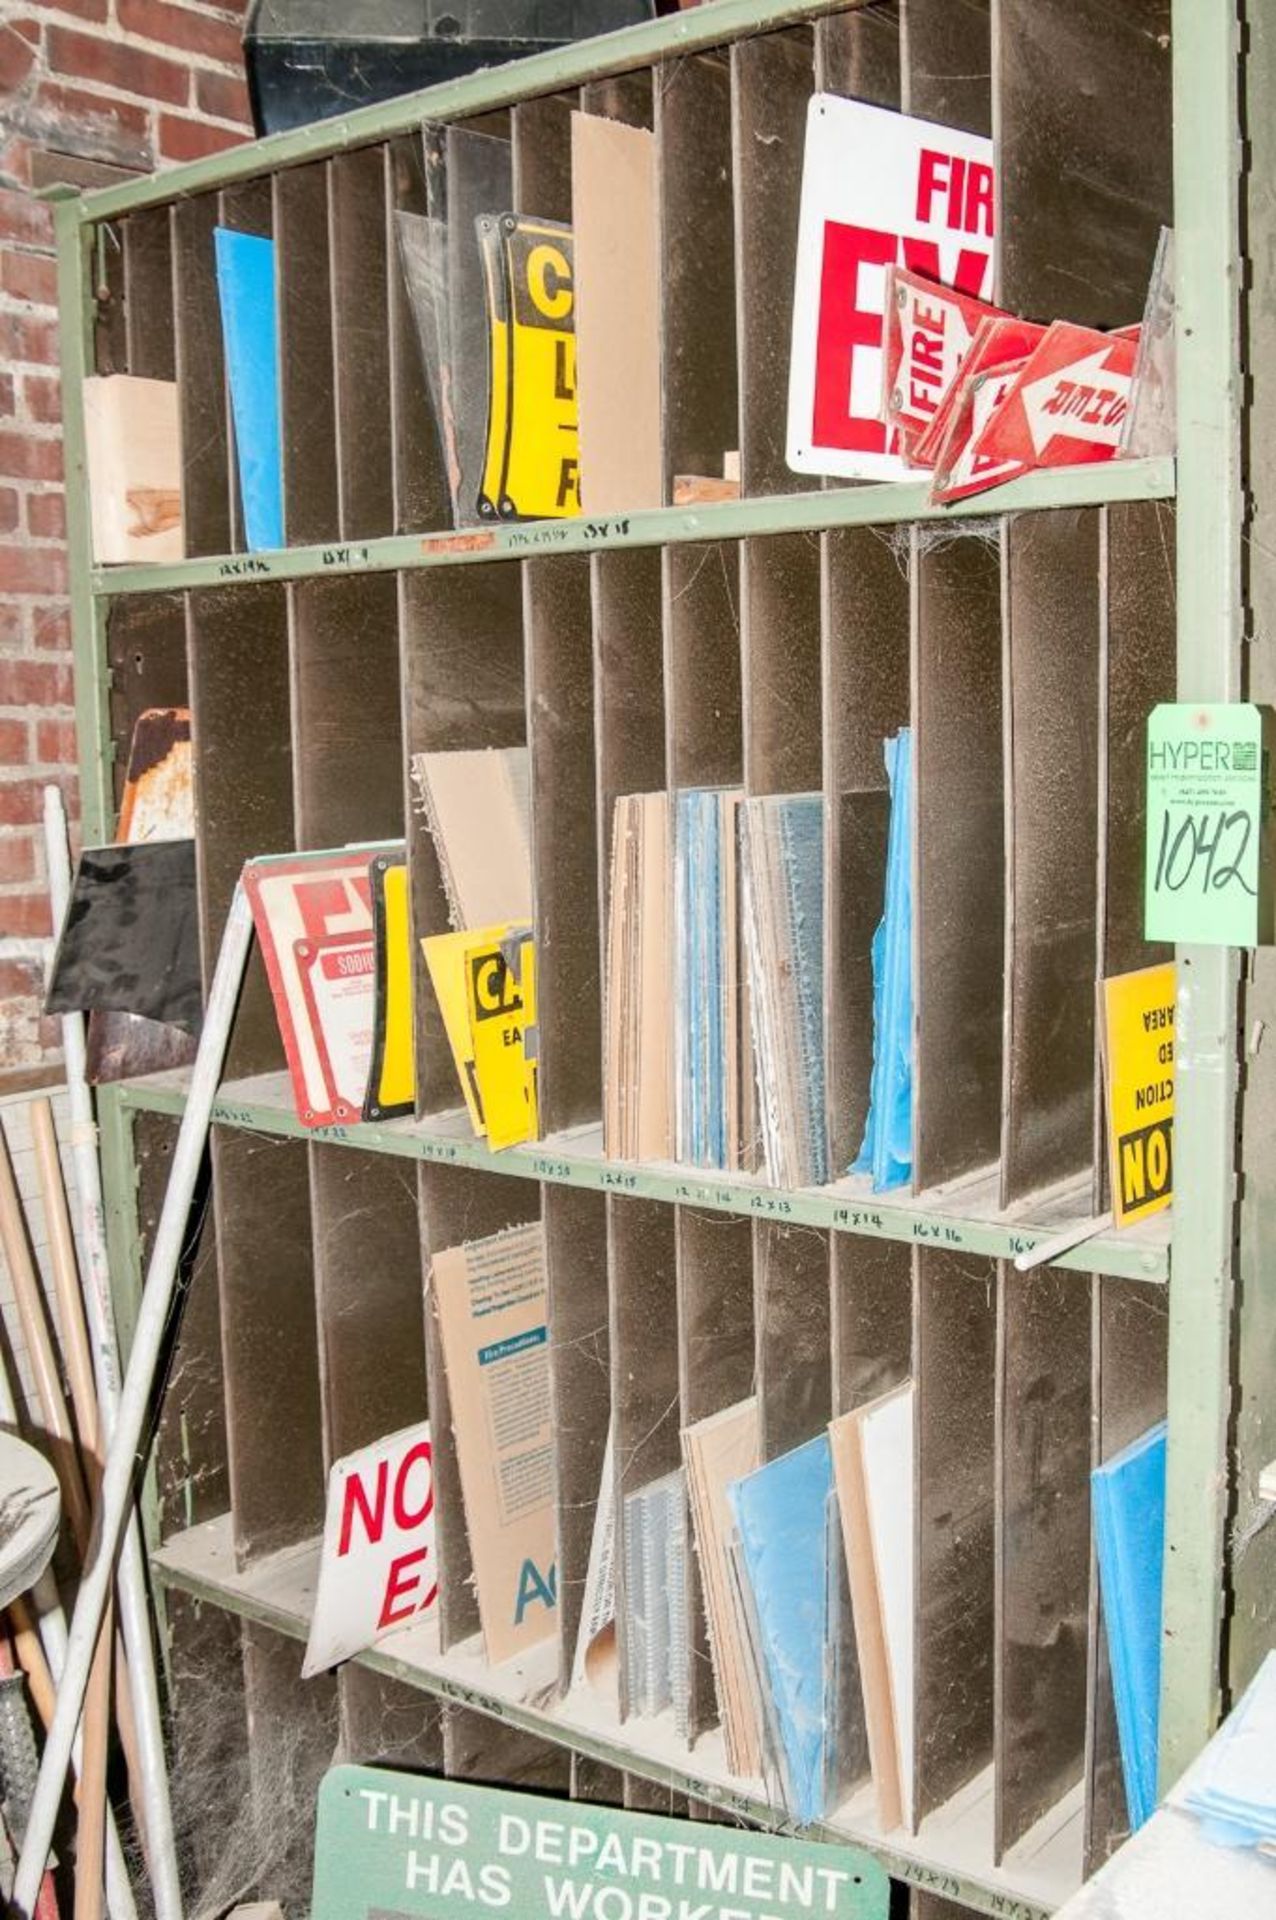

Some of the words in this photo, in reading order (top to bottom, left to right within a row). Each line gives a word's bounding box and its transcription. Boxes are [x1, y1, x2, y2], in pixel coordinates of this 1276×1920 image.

[910, 297, 947, 414] FIRE
[1149, 741, 1231, 770] HYPER
[1154, 808, 1258, 896] 1042
[360, 1789, 470, 1847] THIS
[498, 1814, 849, 1912] DEPARTMENT
[406, 1850, 513, 1908] HAS
